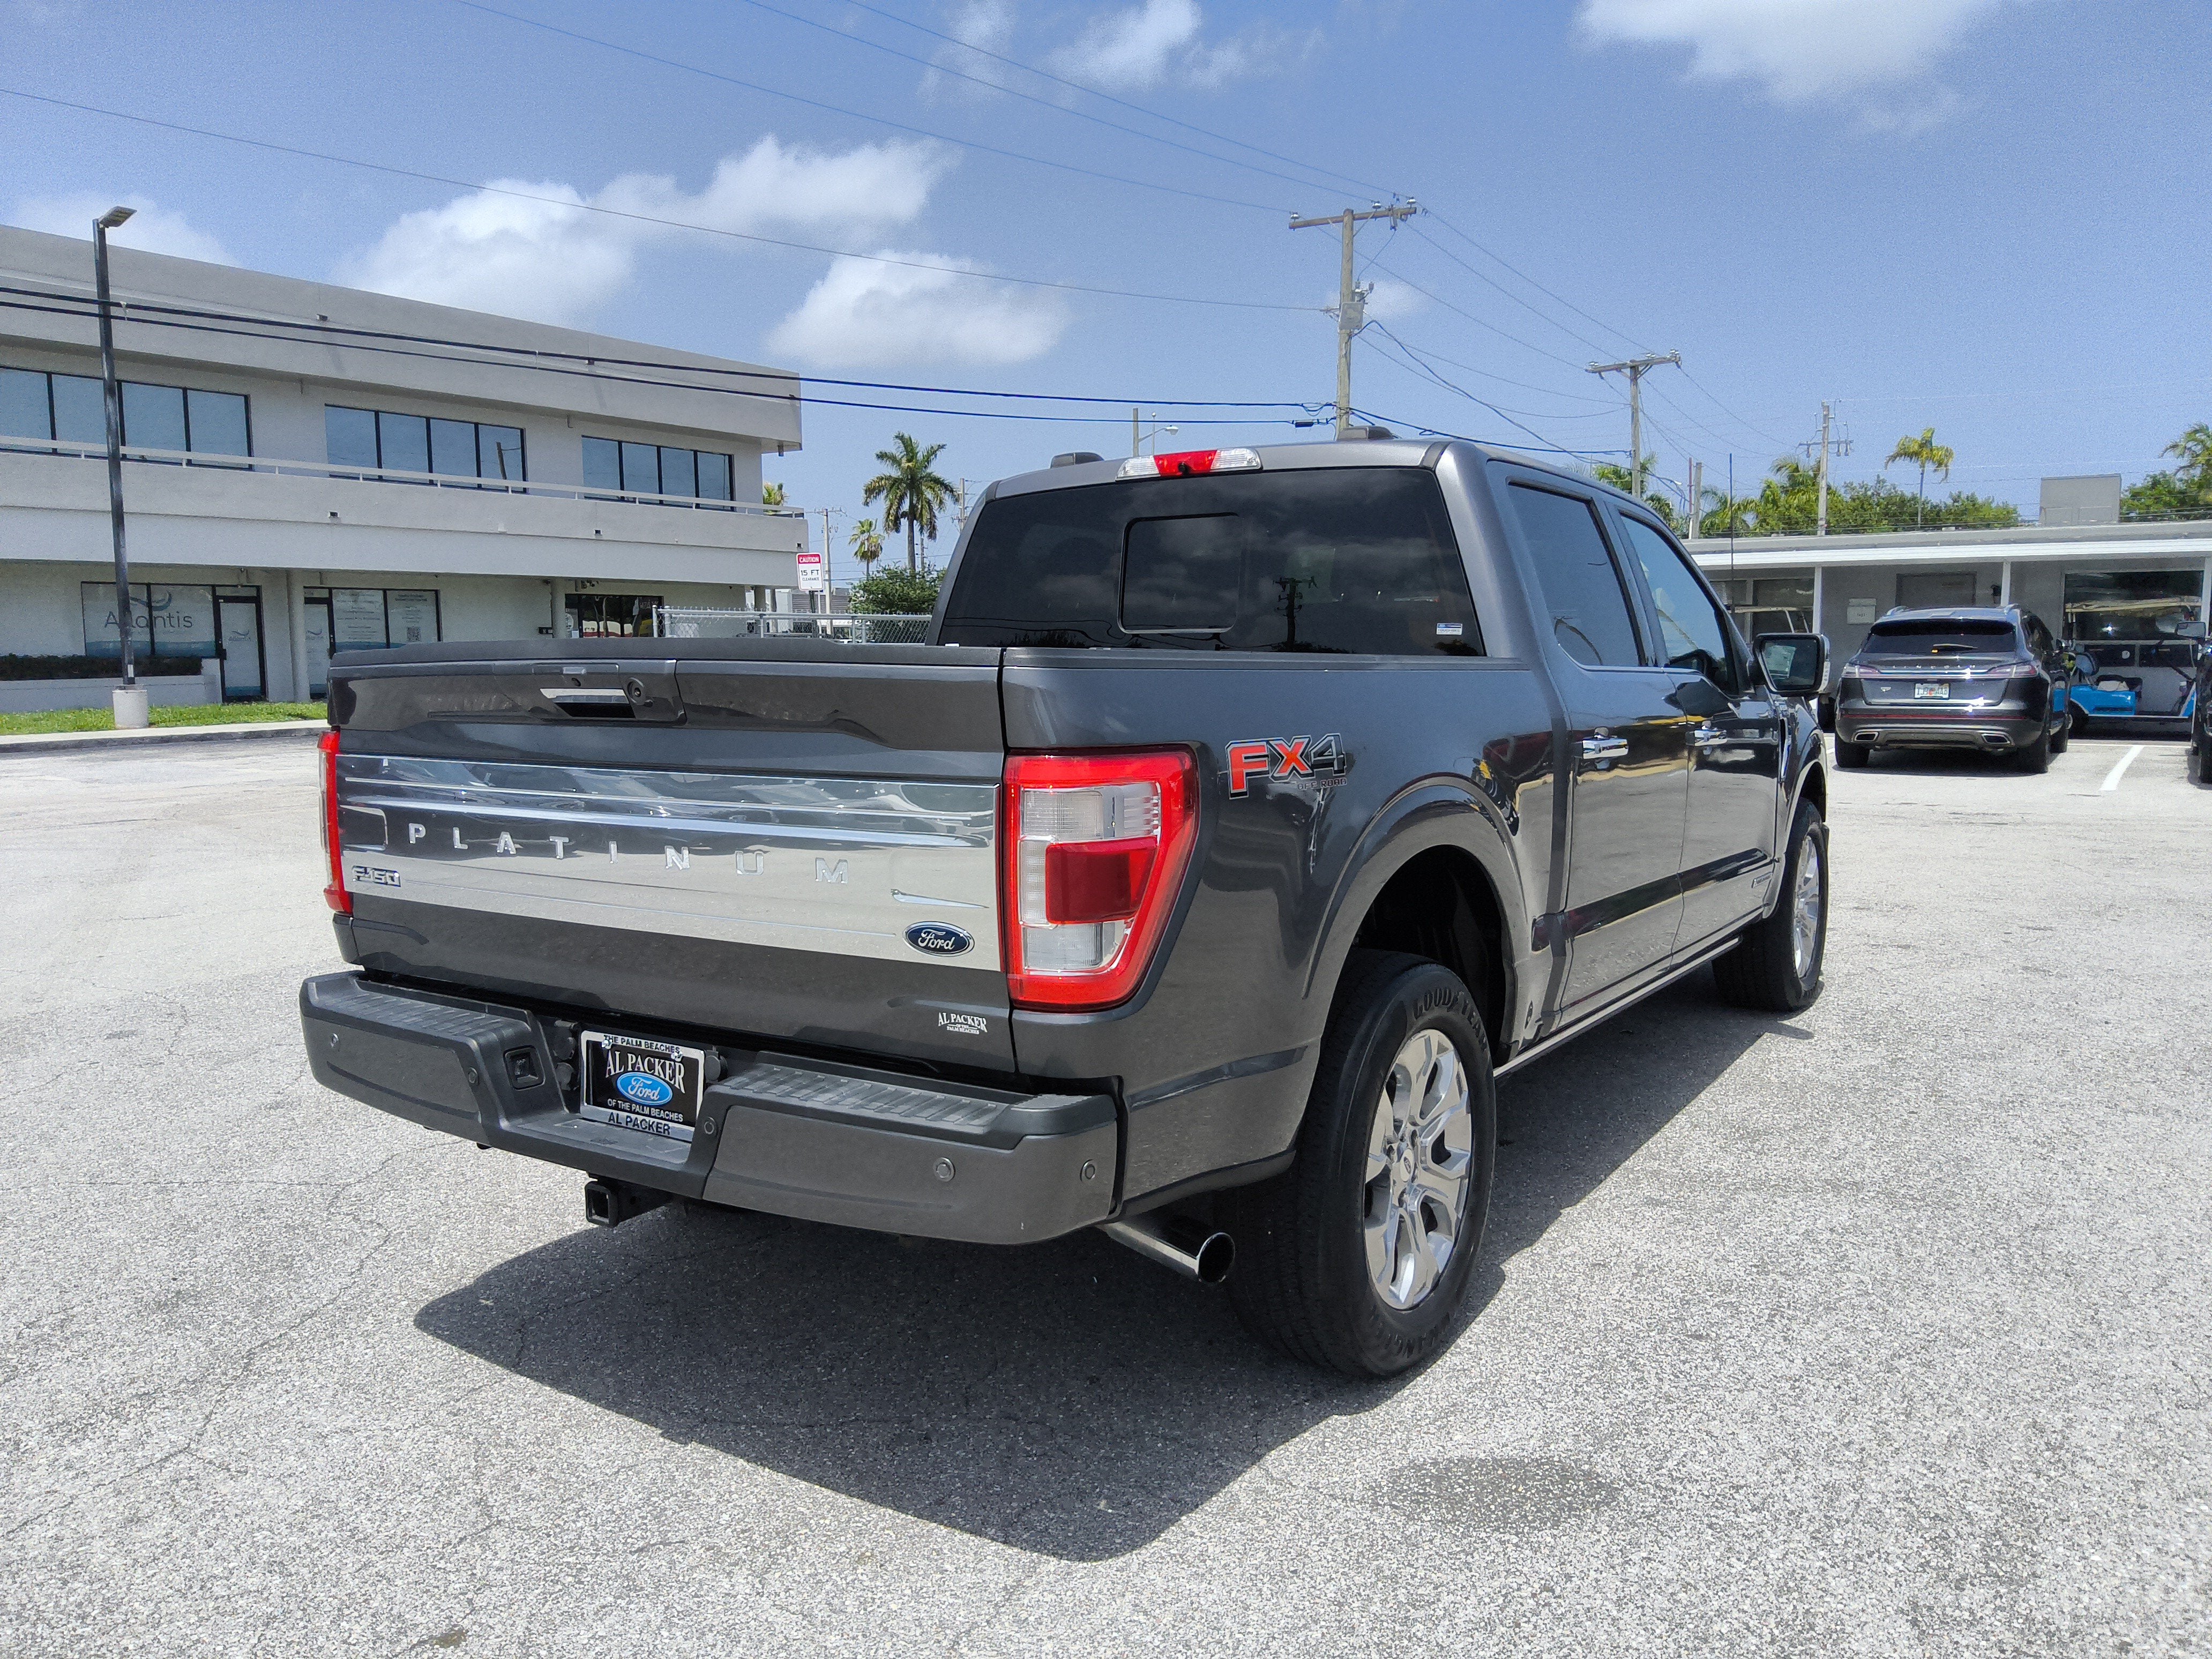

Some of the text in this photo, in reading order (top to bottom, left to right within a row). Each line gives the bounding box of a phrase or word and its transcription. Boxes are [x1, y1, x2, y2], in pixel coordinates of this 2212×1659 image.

[104, 611, 193, 629] Aantis
[1225, 733, 1347, 800] FX4
[1297, 777, 1347, 791] OFF ROAD
[408, 823, 848, 885] PLATINUM
[917, 929, 955, 951] Ford
[938, 1012, 988, 1033] AL PACKER
[604, 1035, 681, 1052] THE PALM BEACHES
[605, 1049, 685, 1094] AL PACKER
[627, 1077, 661, 1101] Ford
[607, 1098, 683, 1122] OF THE PALM BEACHES
[608, 1112, 671, 1135] AL PACKER
